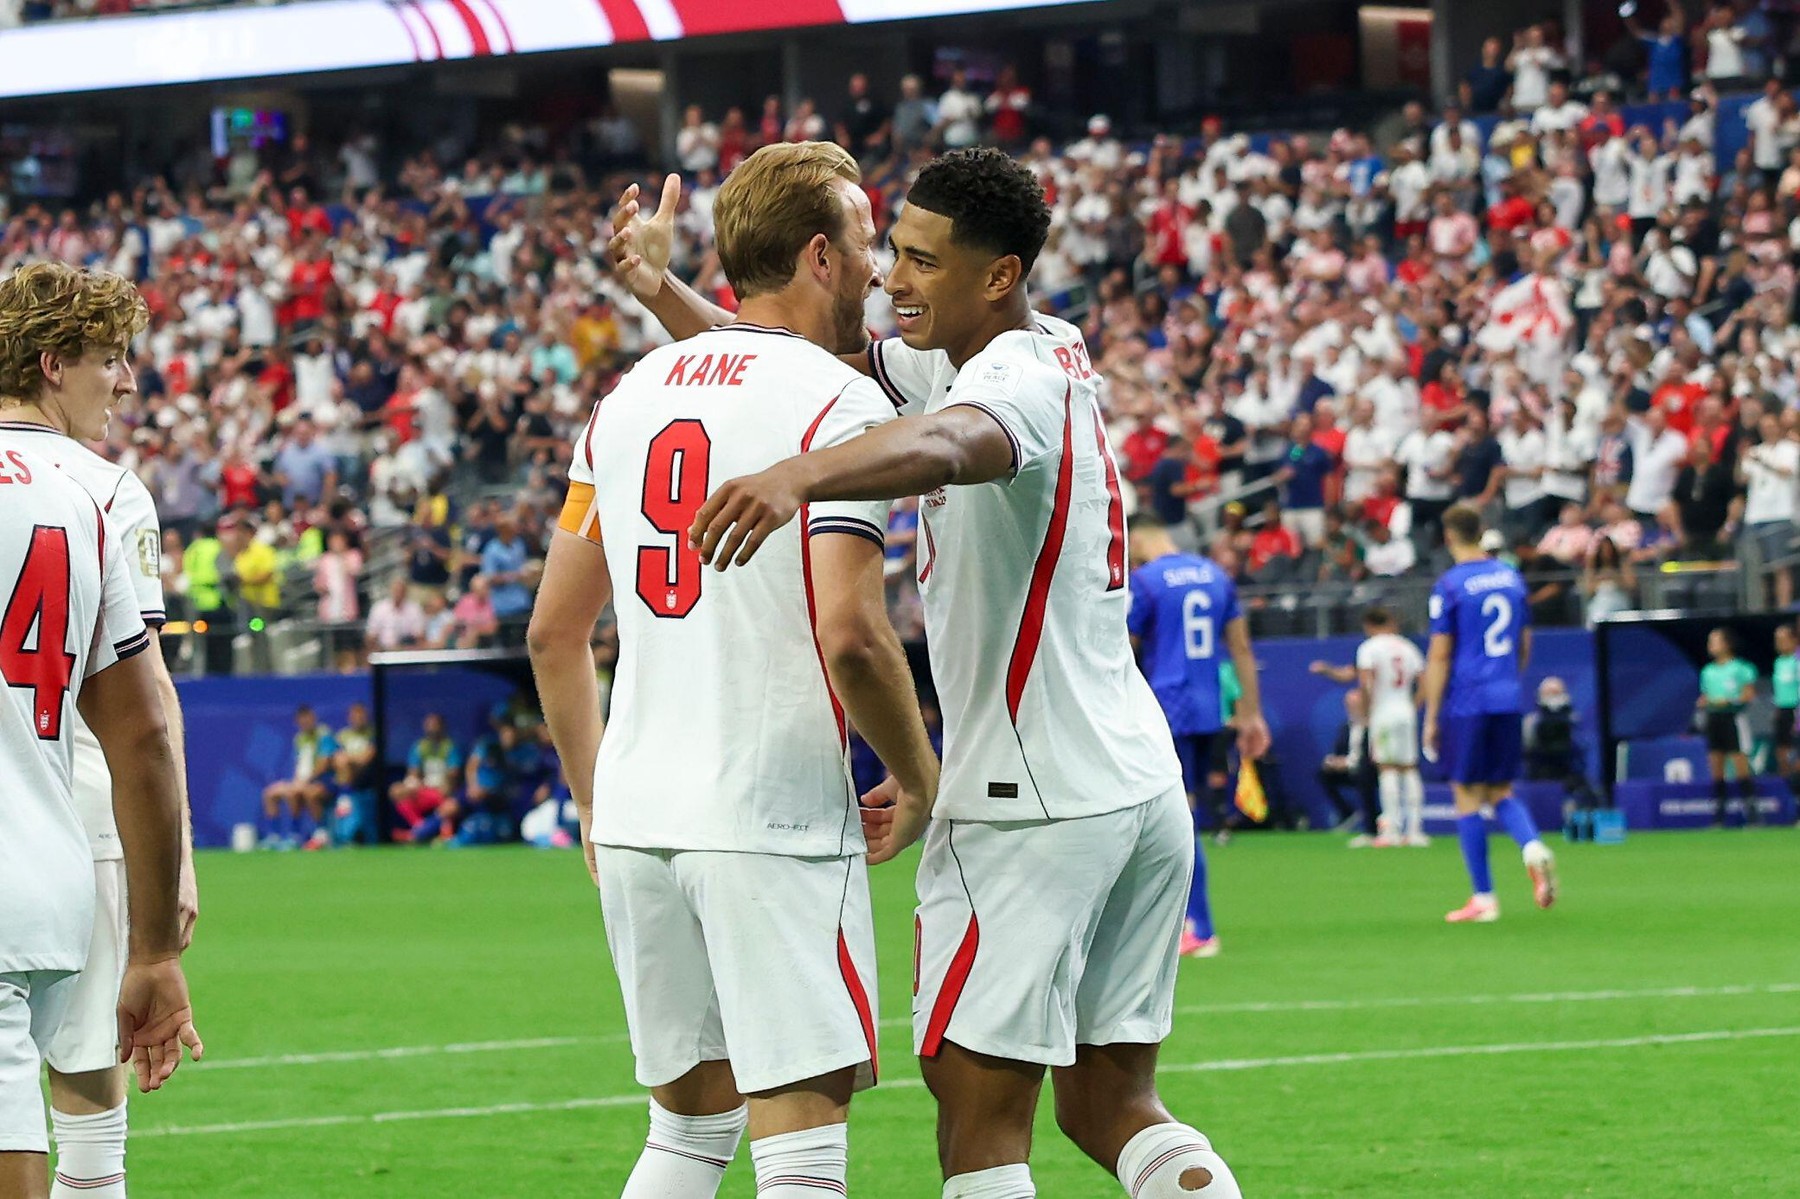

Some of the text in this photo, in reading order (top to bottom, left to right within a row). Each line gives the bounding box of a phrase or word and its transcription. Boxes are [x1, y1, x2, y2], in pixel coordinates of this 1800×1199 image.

[664, 353, 758, 386] KANE
[1053, 341, 1092, 380] BE
[636, 418, 711, 619] 9
[0, 524, 77, 741] 4
[1183, 589, 1213, 660] 6
[1482, 592, 1512, 657] 2
